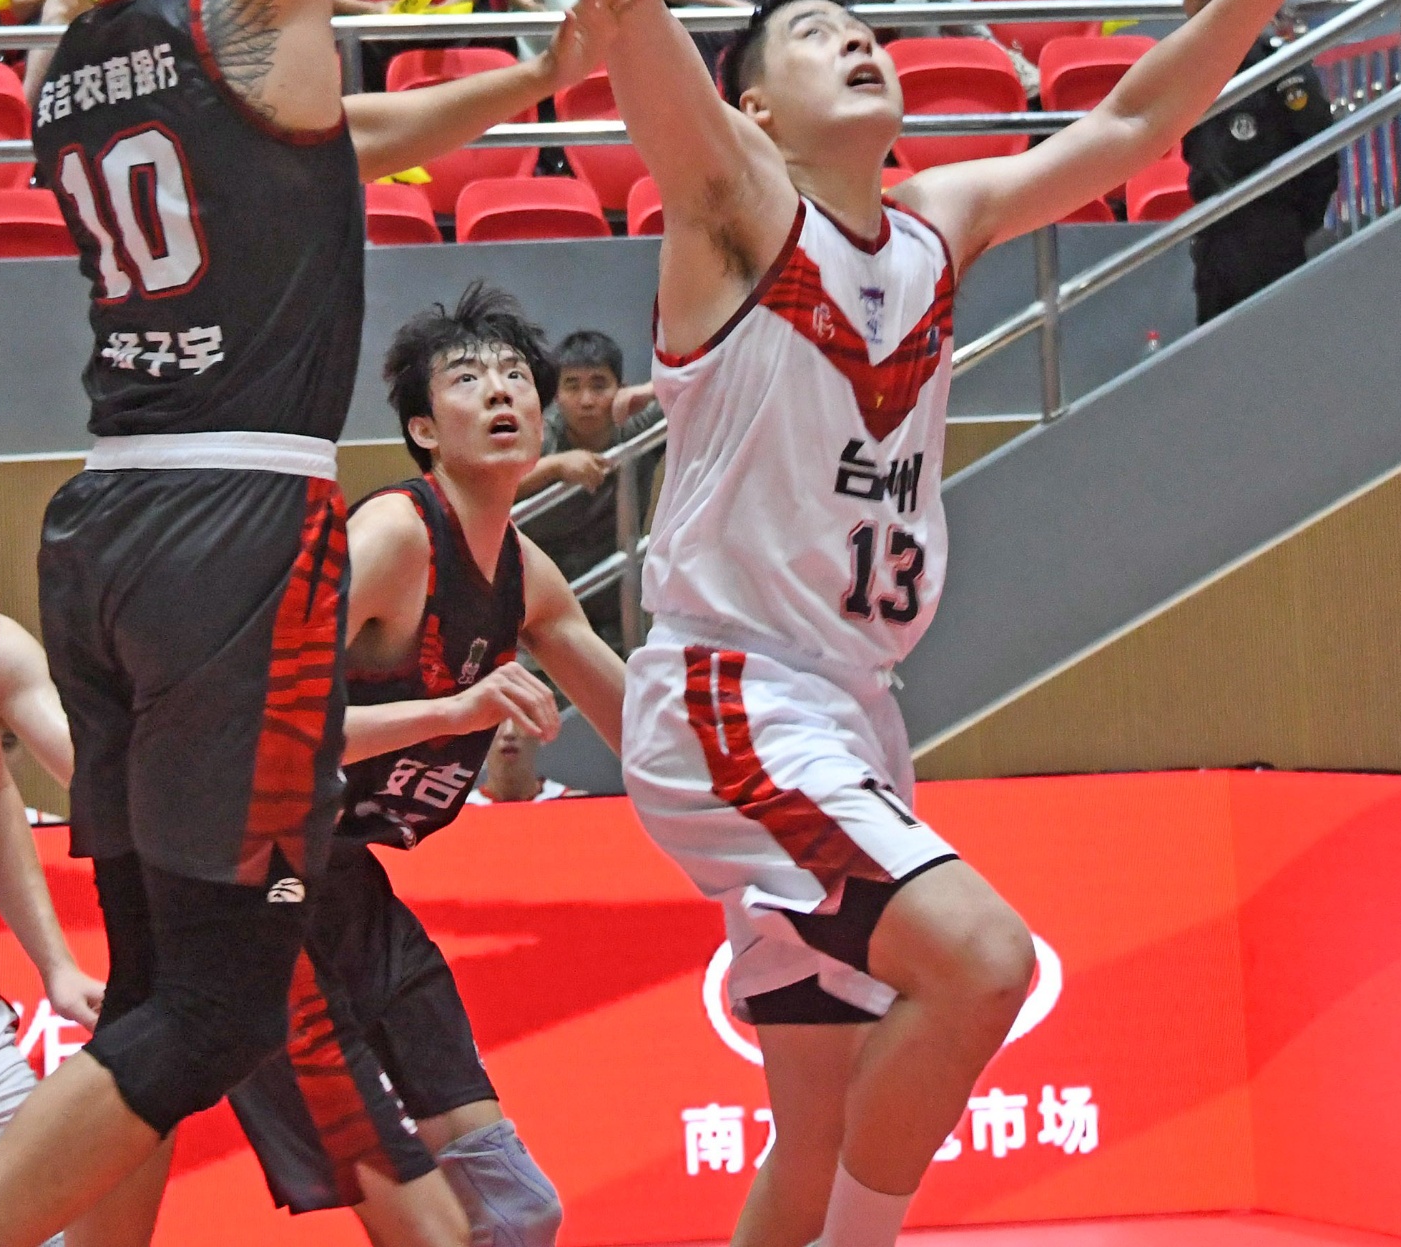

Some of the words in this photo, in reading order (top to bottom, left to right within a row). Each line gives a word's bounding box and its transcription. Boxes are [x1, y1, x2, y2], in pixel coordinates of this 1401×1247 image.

[37, 42, 180, 128] 安吉农商银行
[56, 121, 209, 305] 10
[833, 437, 925, 513] 台州
[840, 519, 925, 626] 13
[681, 1083, 1100, 1176] 南市场
